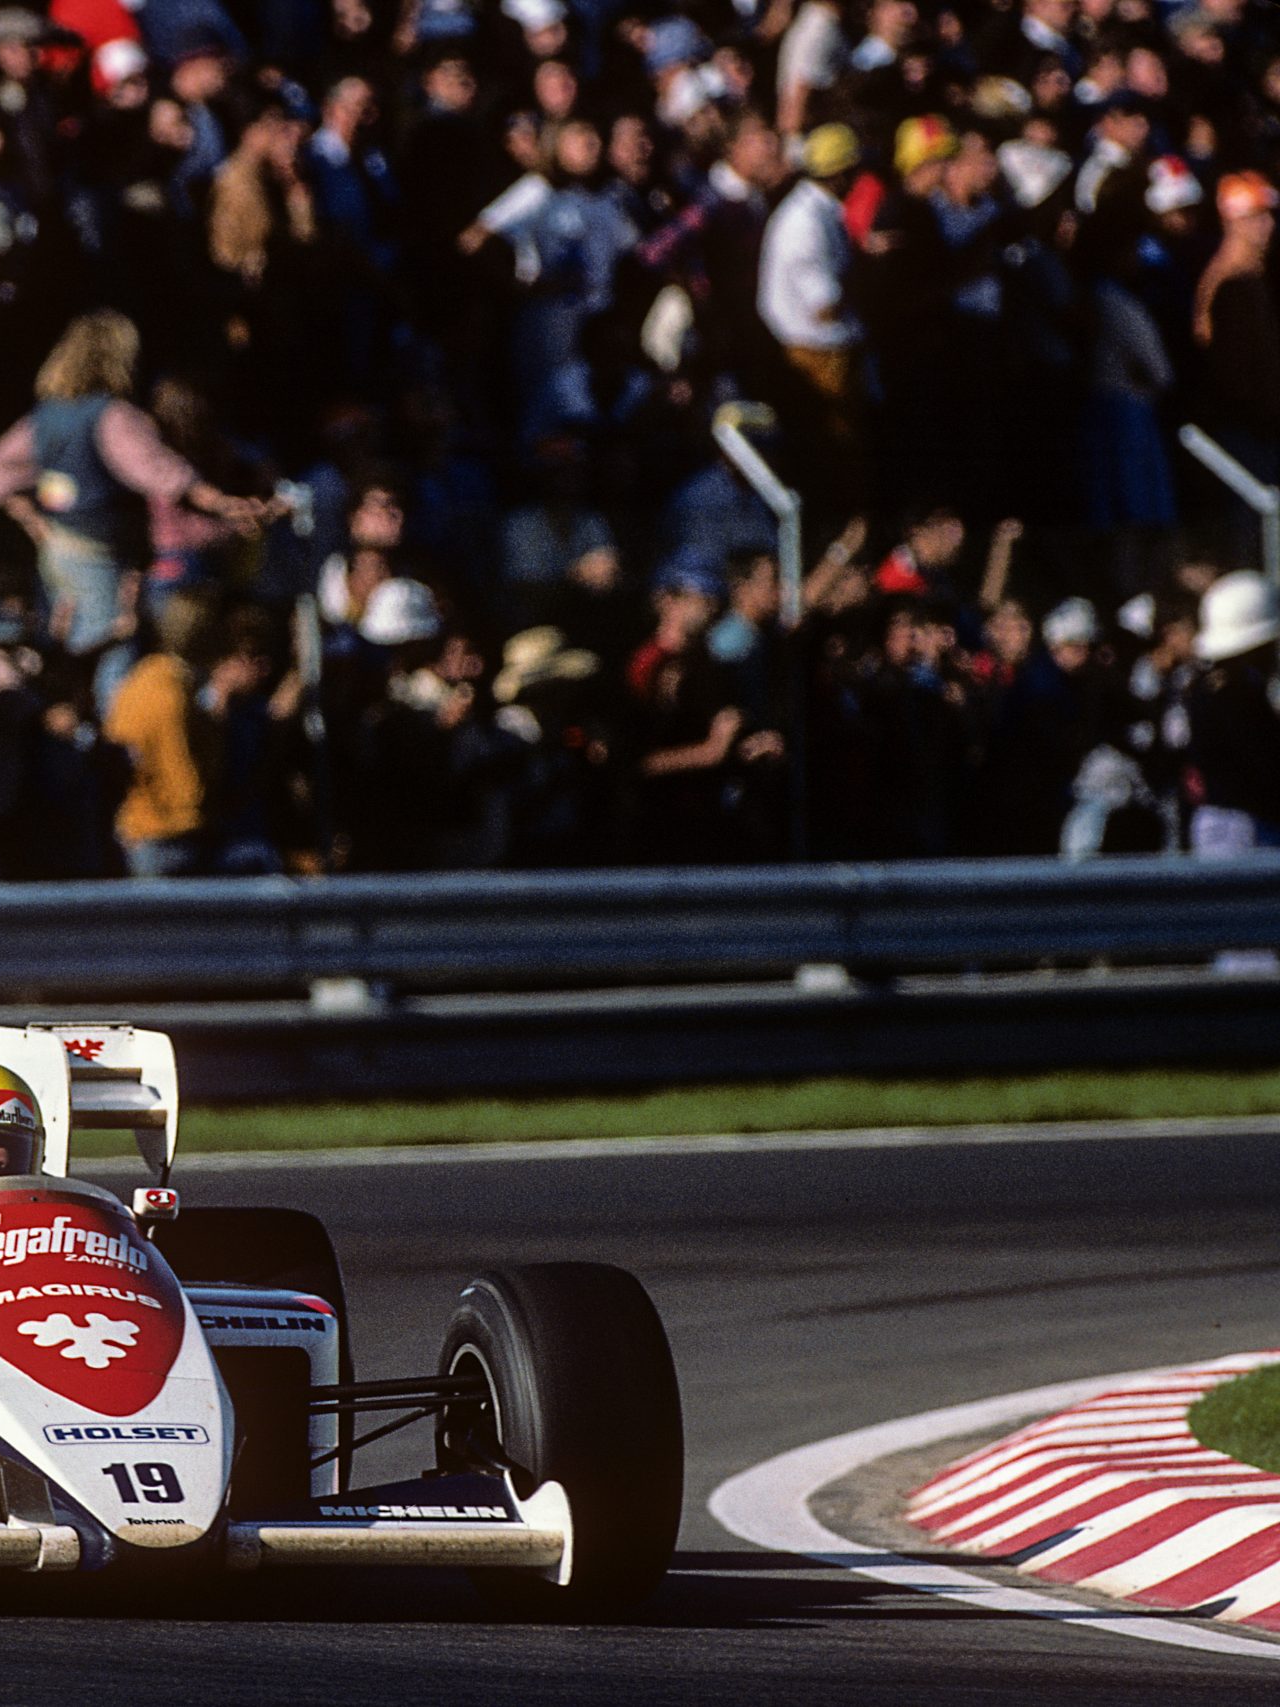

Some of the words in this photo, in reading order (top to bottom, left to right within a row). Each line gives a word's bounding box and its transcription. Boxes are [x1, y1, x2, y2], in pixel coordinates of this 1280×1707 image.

[64, 1253, 141, 1275] ZANETTI
[196, 1315, 326, 1332] CHELIN
[52, 1427, 198, 1440] HOLSET
[101, 1462, 185, 1503] 19
[320, 1505, 507, 1518] MICHELIN
